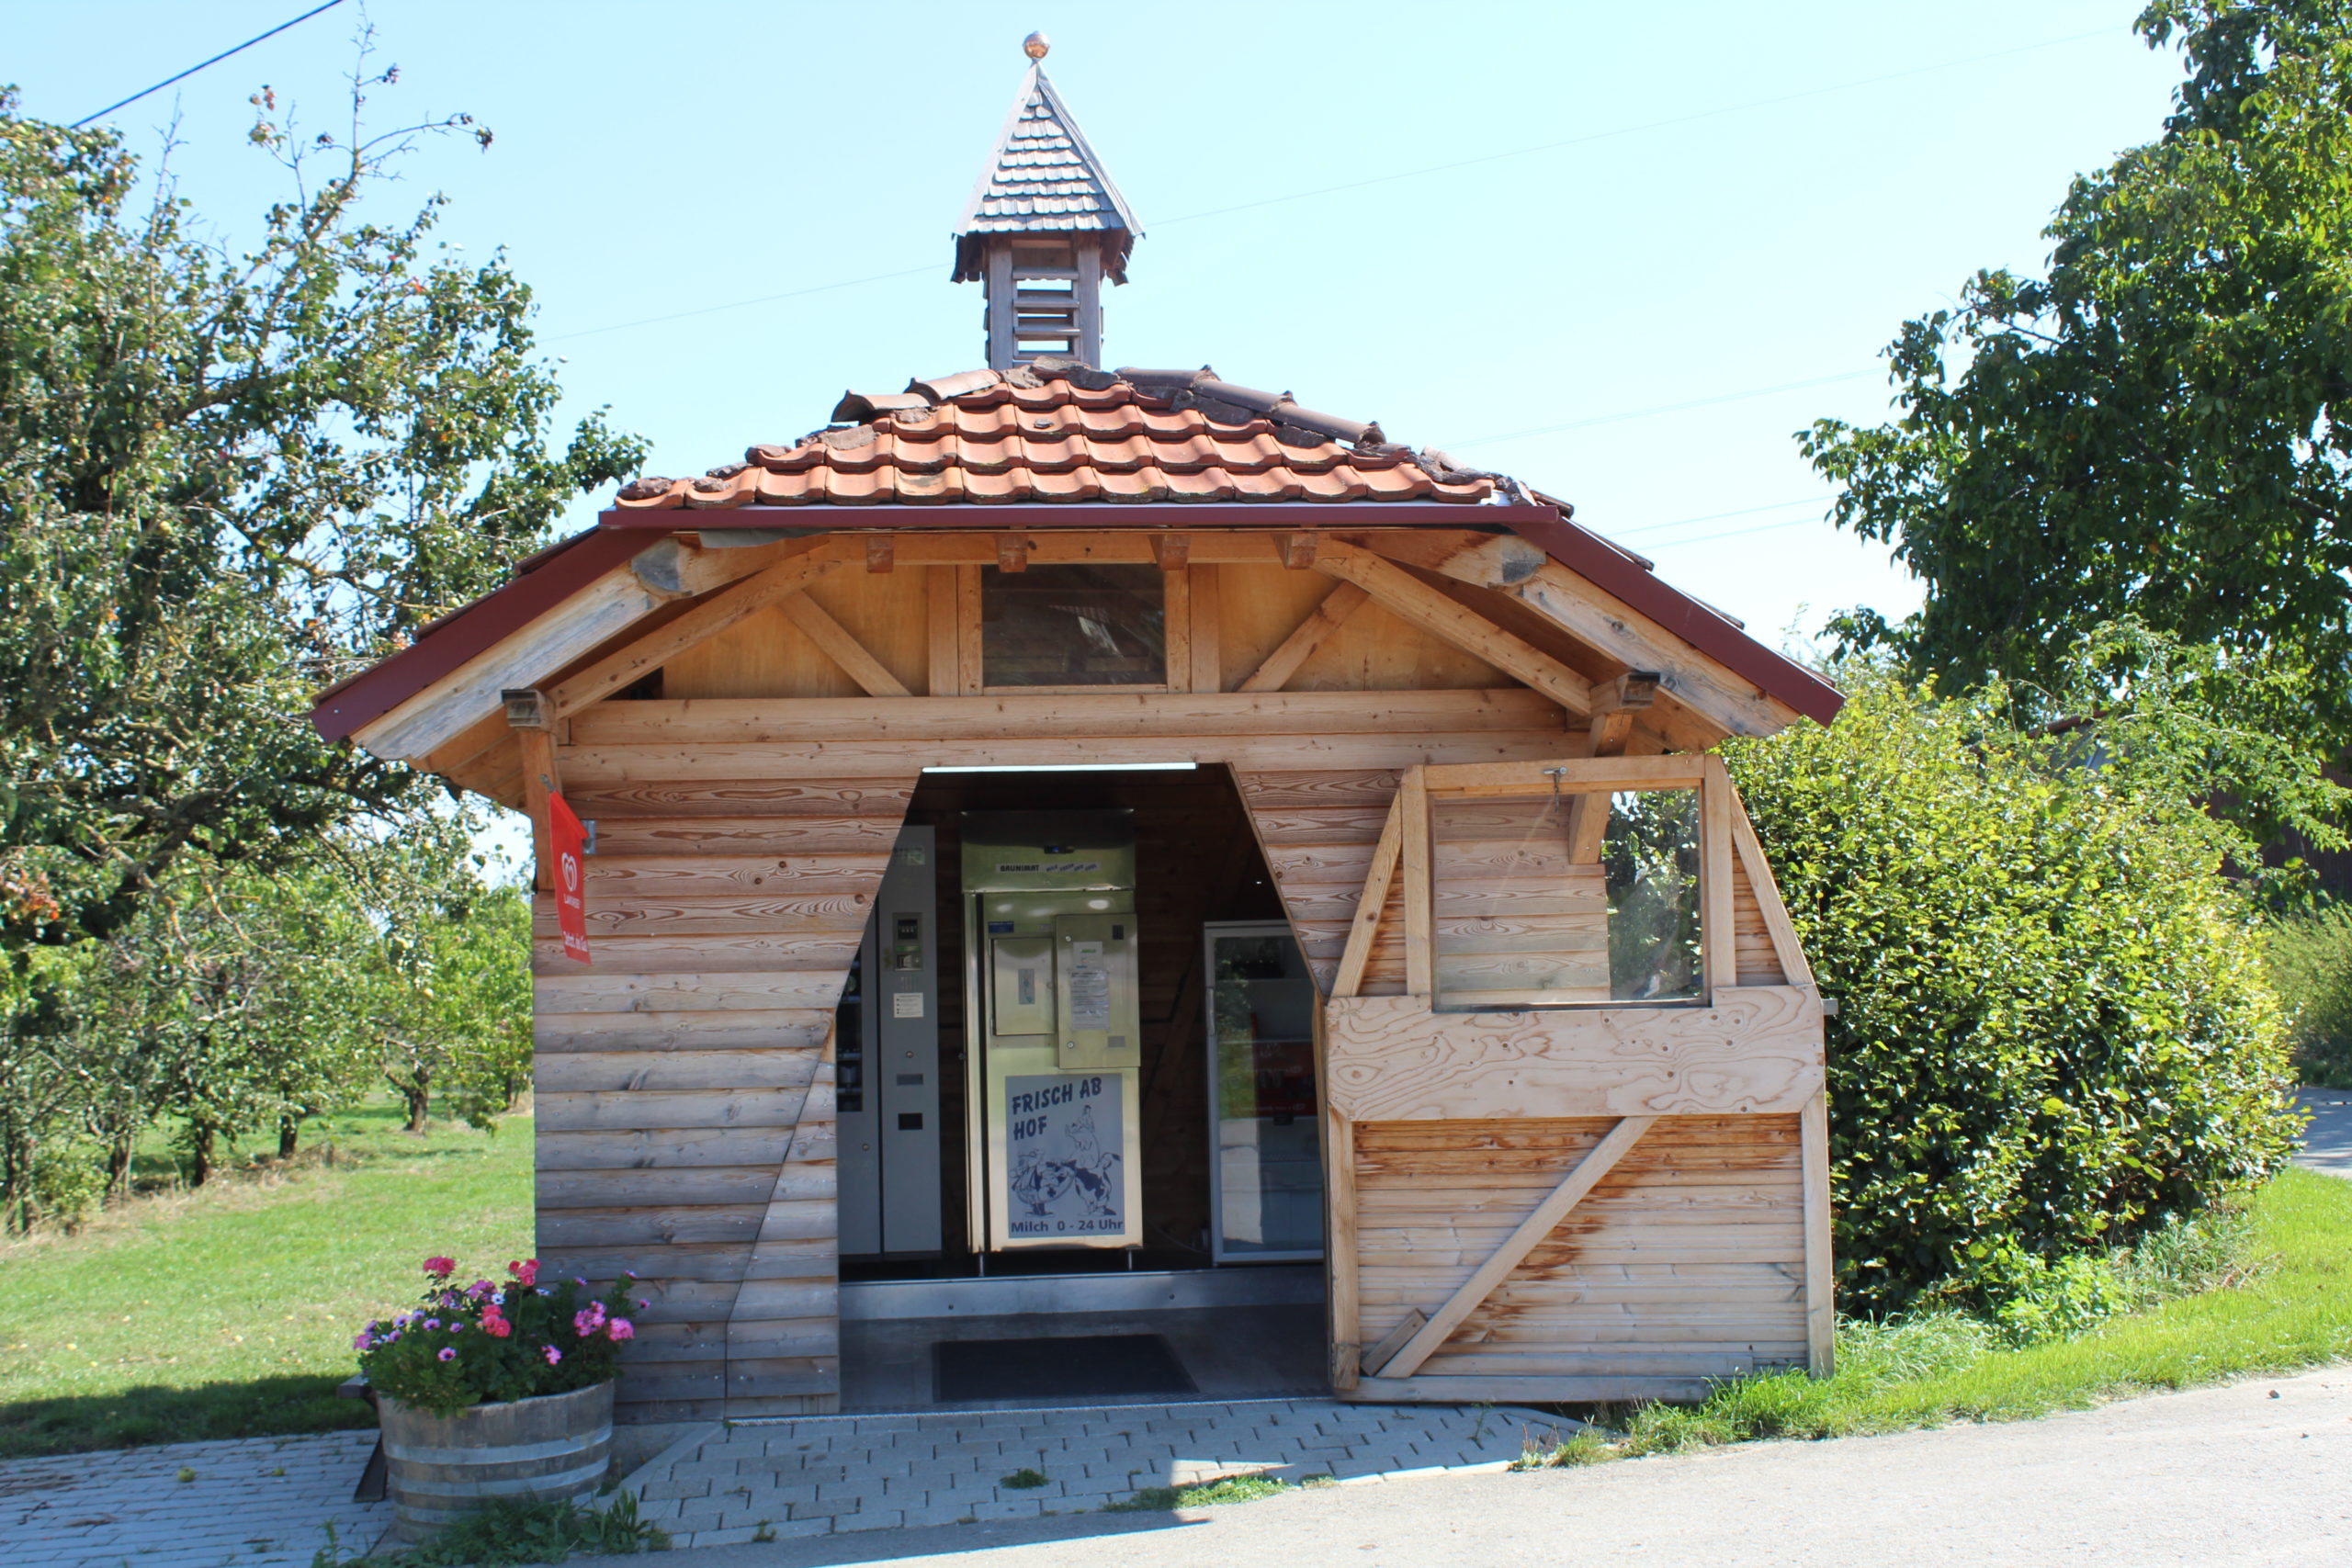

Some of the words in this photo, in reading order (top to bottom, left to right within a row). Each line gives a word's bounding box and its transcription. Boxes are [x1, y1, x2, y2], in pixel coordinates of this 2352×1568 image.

[1012, 1082, 1073, 1115] FRISCH
[1080, 1077, 1102, 1099] AB
[1012, 1115, 1047, 1141] HOF
[1011, 1220, 1049, 1233] Milch
[1057, 1220, 1066, 1231] 0
[1078, 1220, 1094, 1231] 24
[1098, 1218, 1124, 1230] Uhr
